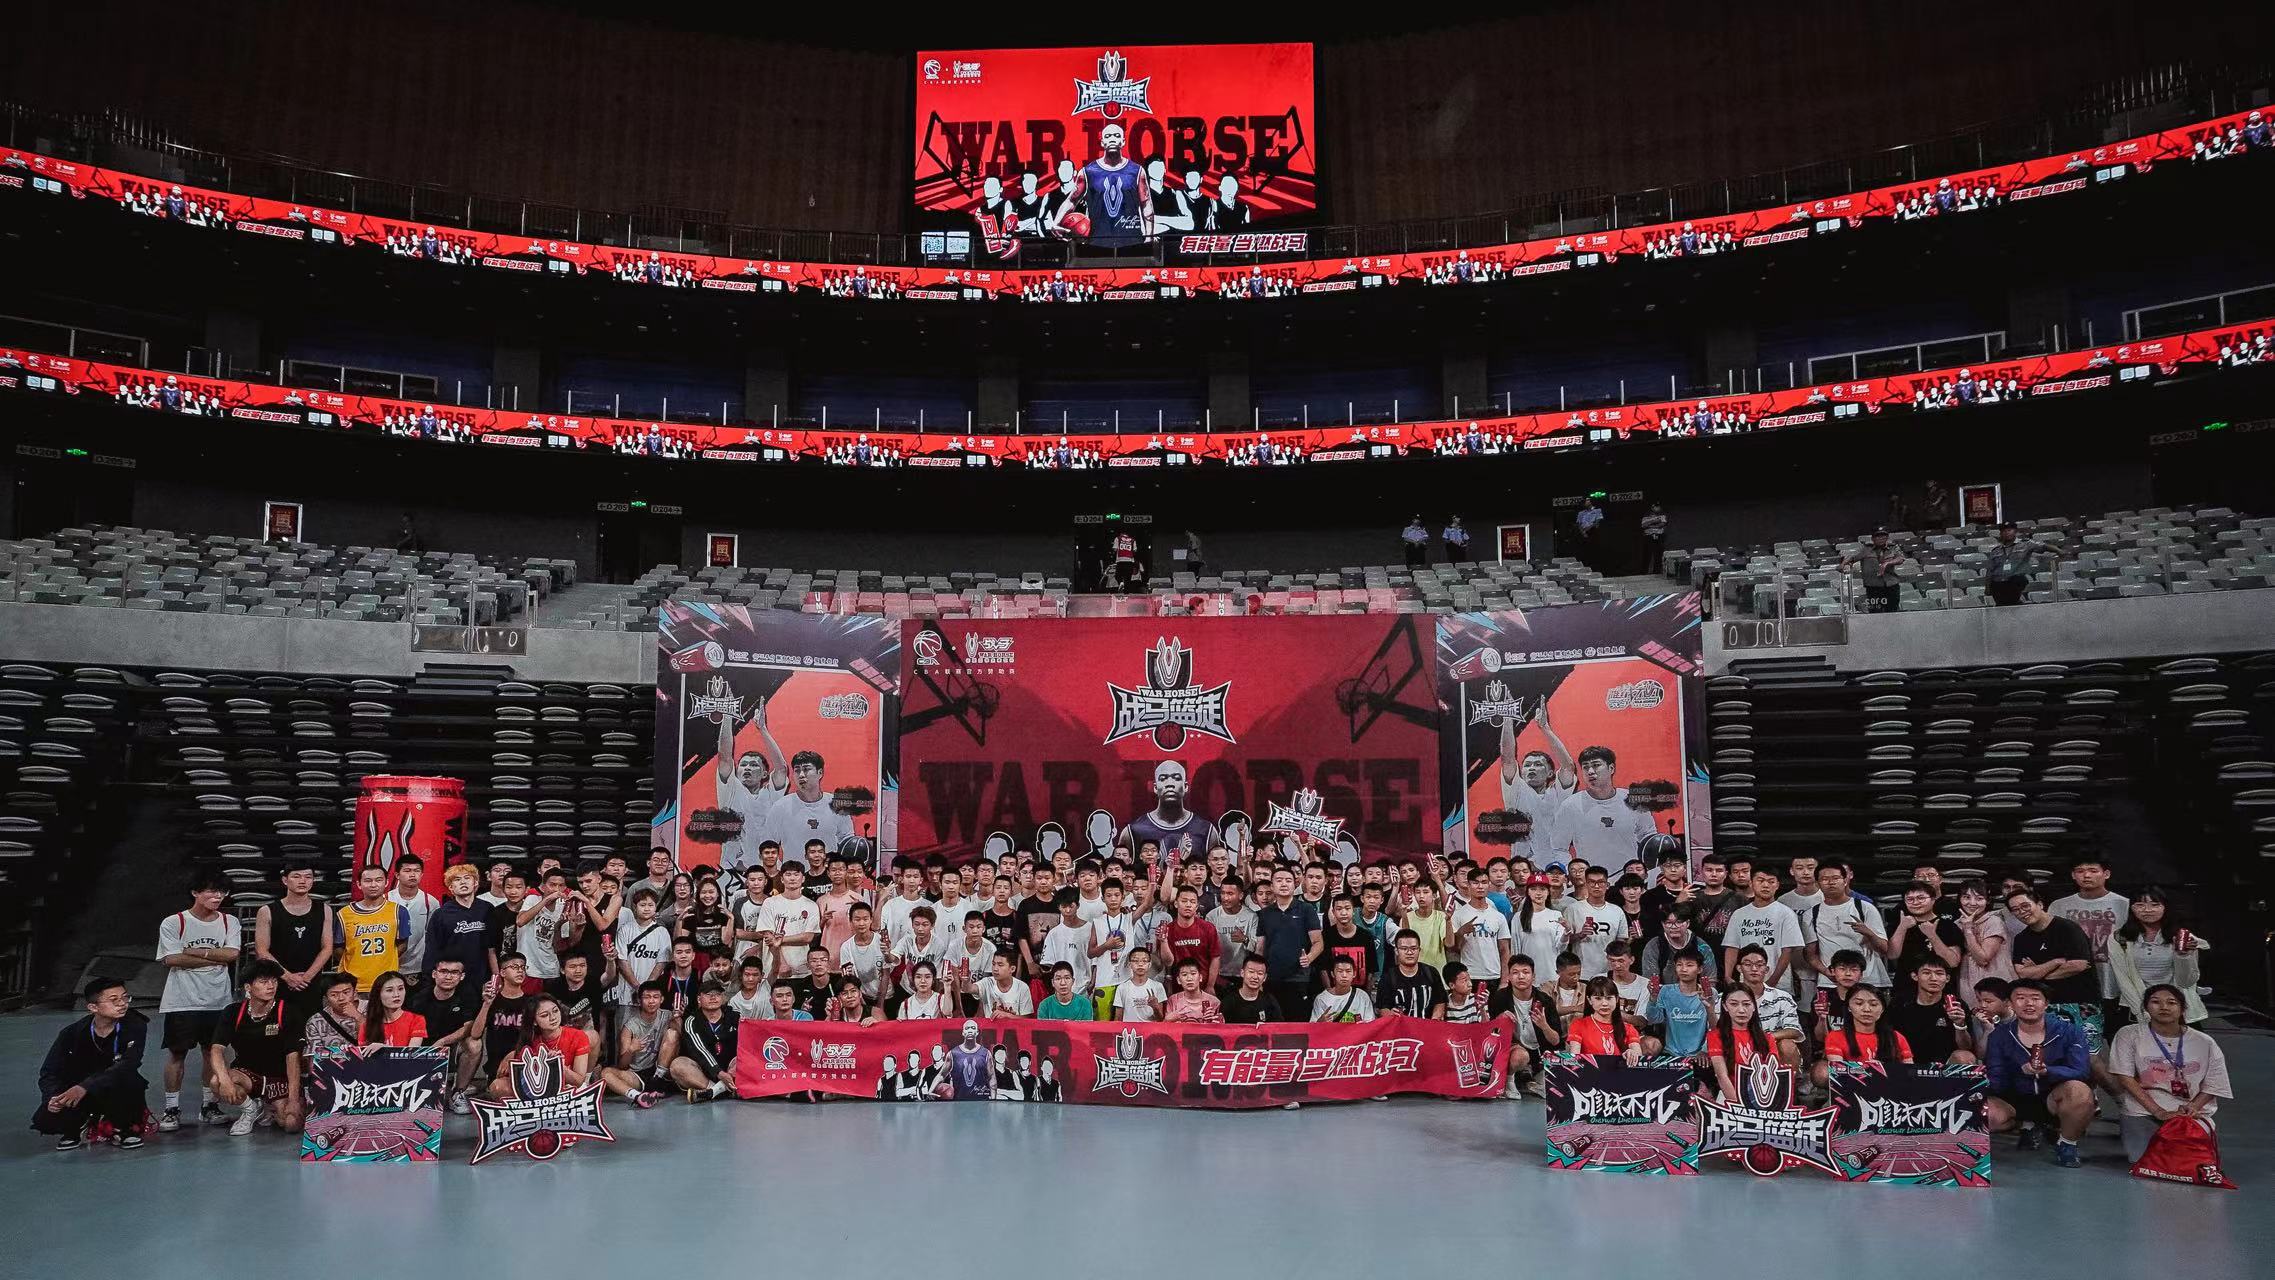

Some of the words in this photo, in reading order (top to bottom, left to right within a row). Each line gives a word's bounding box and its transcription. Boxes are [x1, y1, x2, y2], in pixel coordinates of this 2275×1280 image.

[940, 118, 1067, 175] WAR
[1141, 688, 1163, 697] WAR
[1164, 687, 1198, 698] HORSE
[1113, 690, 1229, 738] 战马篮徒
[920, 760, 1100, 845] WAR
[354, 923, 390, 938] LAKERS
[360, 936, 386, 956] 23
[1174, 938, 1201, 947] wassup
[943, 1029, 1080, 1097] AR
[1199, 1048, 1301, 1086] 有能量
[508, 1099, 531, 1110] WAR
[532, 1094, 570, 1108] HORSE
[1733, 1107, 1757, 1118] WAR
[1759, 1108, 1798, 1120] HORSE
[480, 1094, 602, 1150] 战马篮徒
[1702, 1107, 1832, 1161] 战马篮徒
